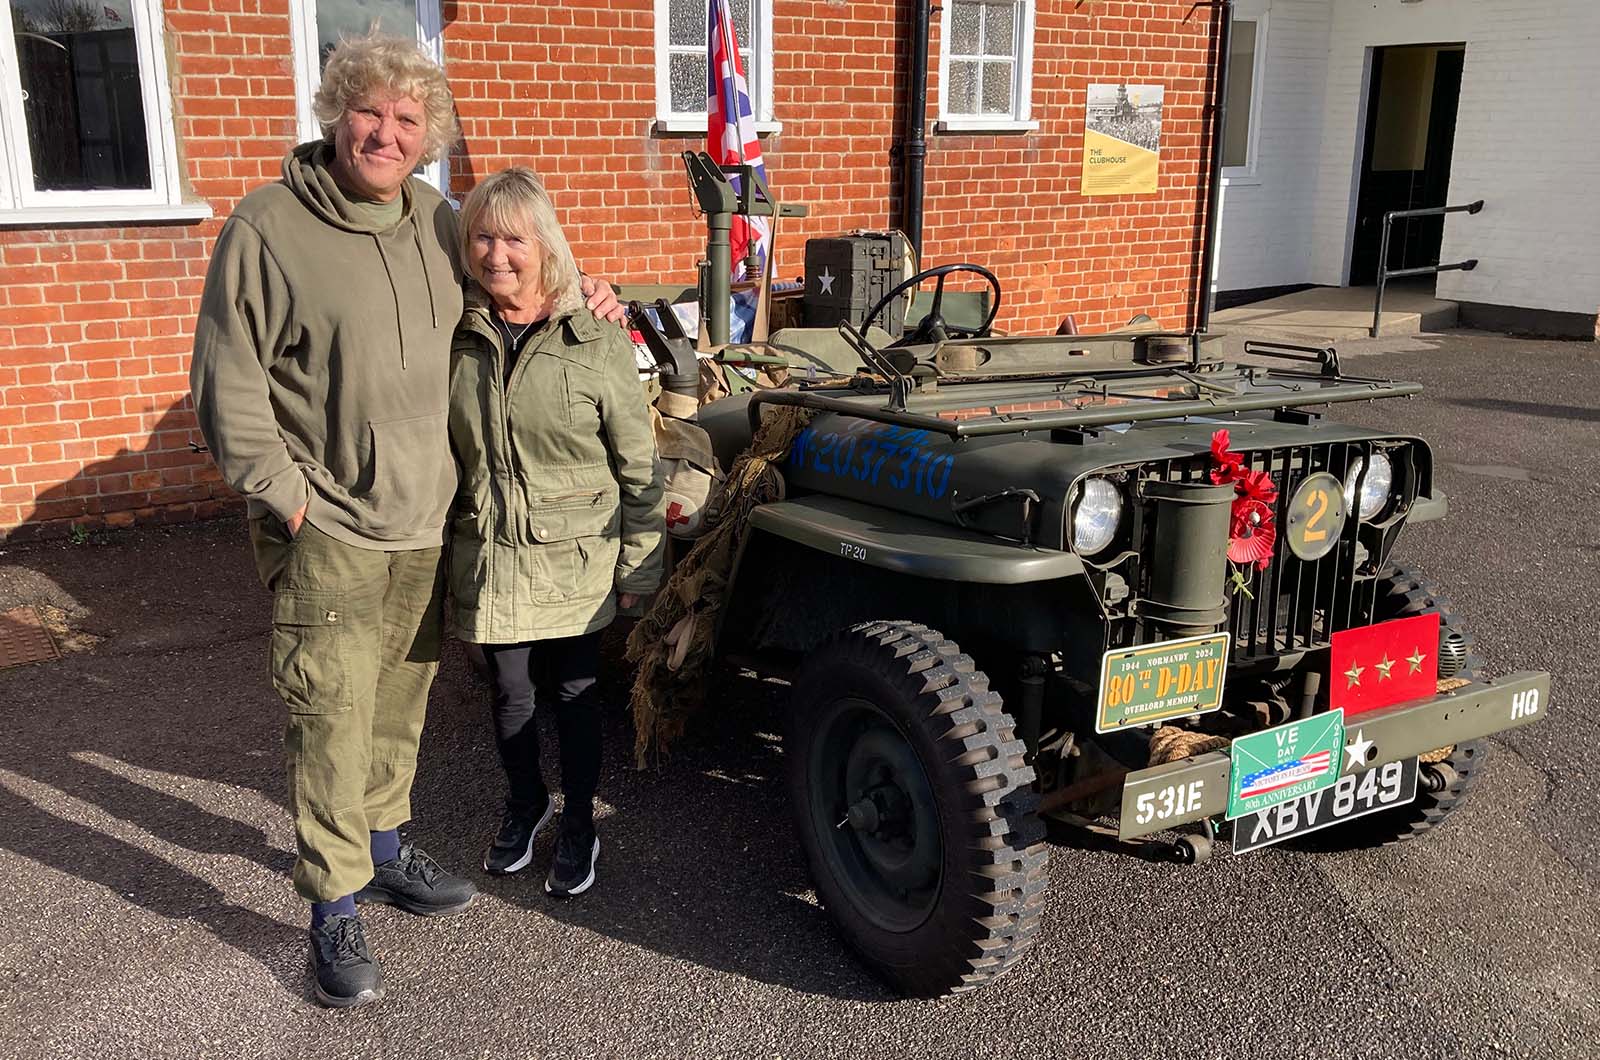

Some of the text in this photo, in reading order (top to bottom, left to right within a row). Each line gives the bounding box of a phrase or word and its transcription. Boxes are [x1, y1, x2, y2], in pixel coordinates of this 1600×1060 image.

[1089, 156, 1127, 164] CLUBHOUSE
[1303, 489, 1329, 543] 2
[840, 542, 867, 560] TP 20
[1121, 647, 1214, 672] 1944 NORMANDY 2024
[1156, 658, 1220, 698] D-DAY
[1124, 694, 1199, 715] OVERLORD MEMORY
[1511, 688, 1539, 720] HQ
[1275, 726, 1299, 747] VE
[1277, 745, 1297, 758] DAY
[1136, 780, 1204, 824] 531E
[1251, 760, 1403, 843] XBV 849
[1261, 779, 1319, 806] ANNIVERSARY
